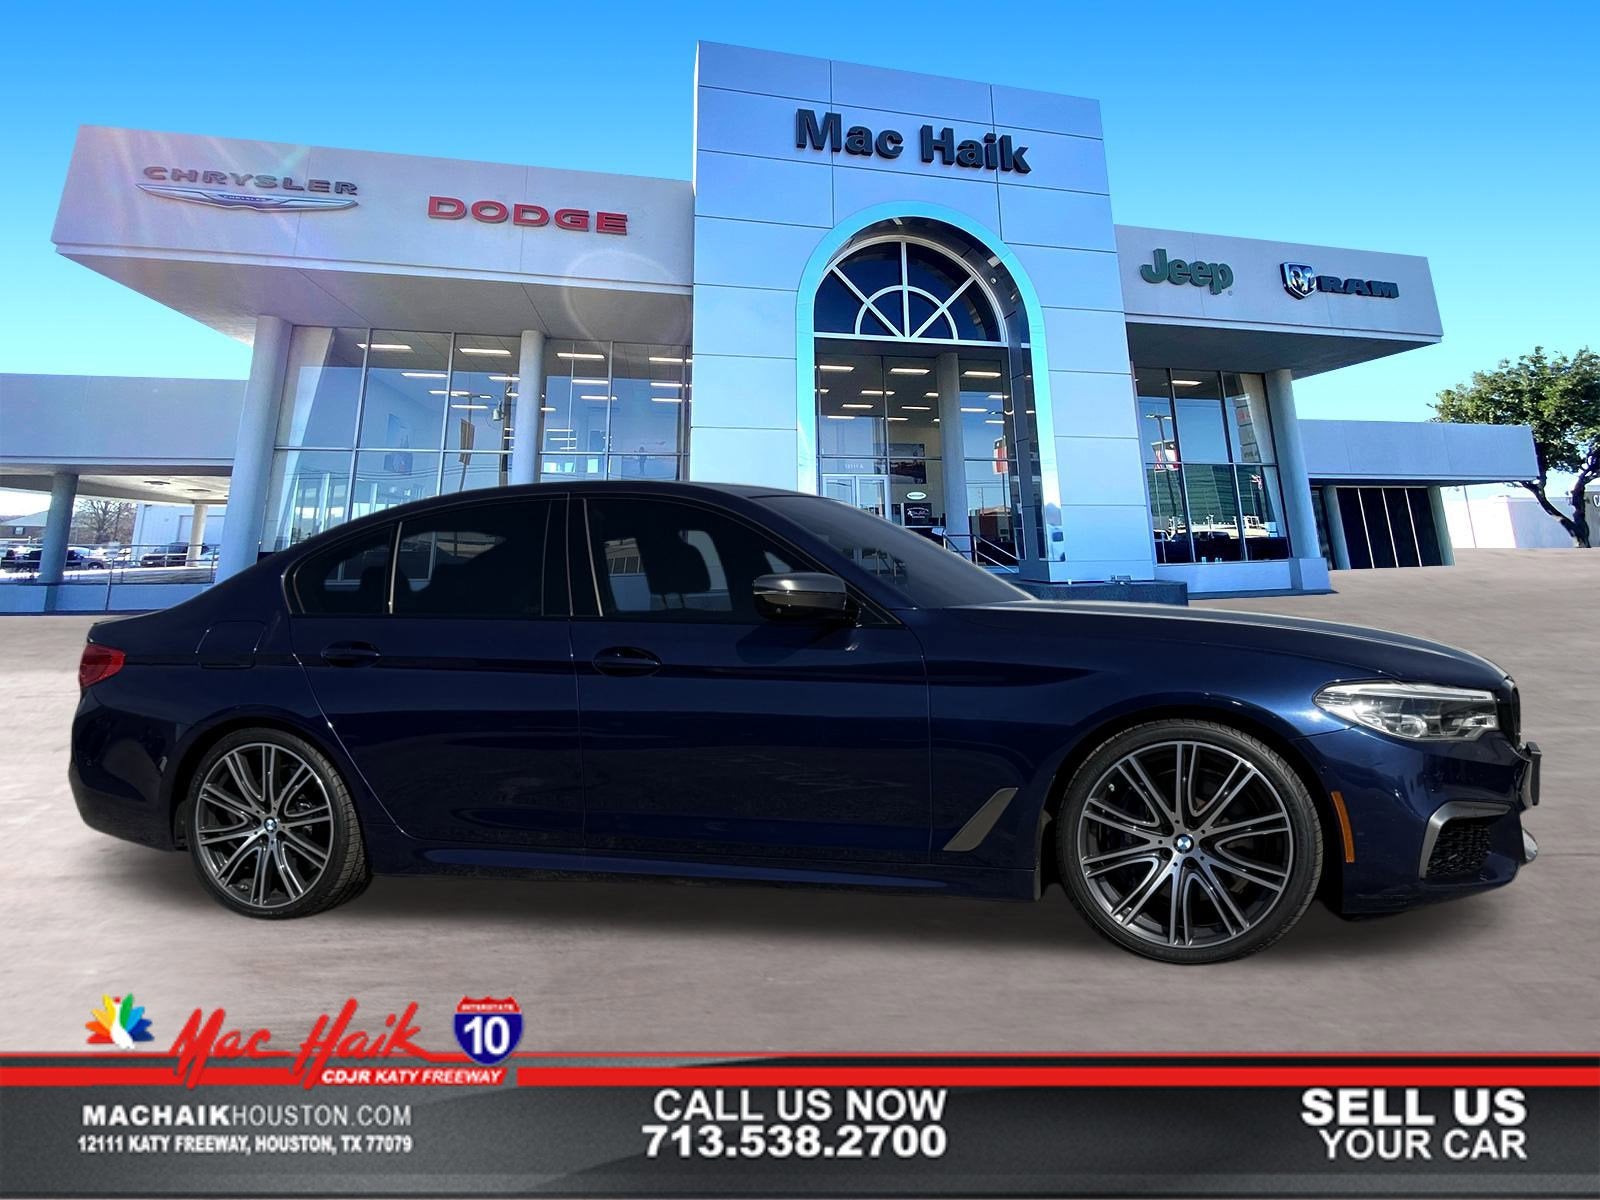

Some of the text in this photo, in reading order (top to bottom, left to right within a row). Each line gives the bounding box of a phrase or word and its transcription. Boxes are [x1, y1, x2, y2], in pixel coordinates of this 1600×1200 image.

[794, 107, 1032, 175] Mac Haik
[143, 165, 359, 196] CHRYSLER
[428, 195, 629, 236] DODGE
[1140, 248, 1234, 296] Jeep
[1315, 275, 1400, 300] RAM
